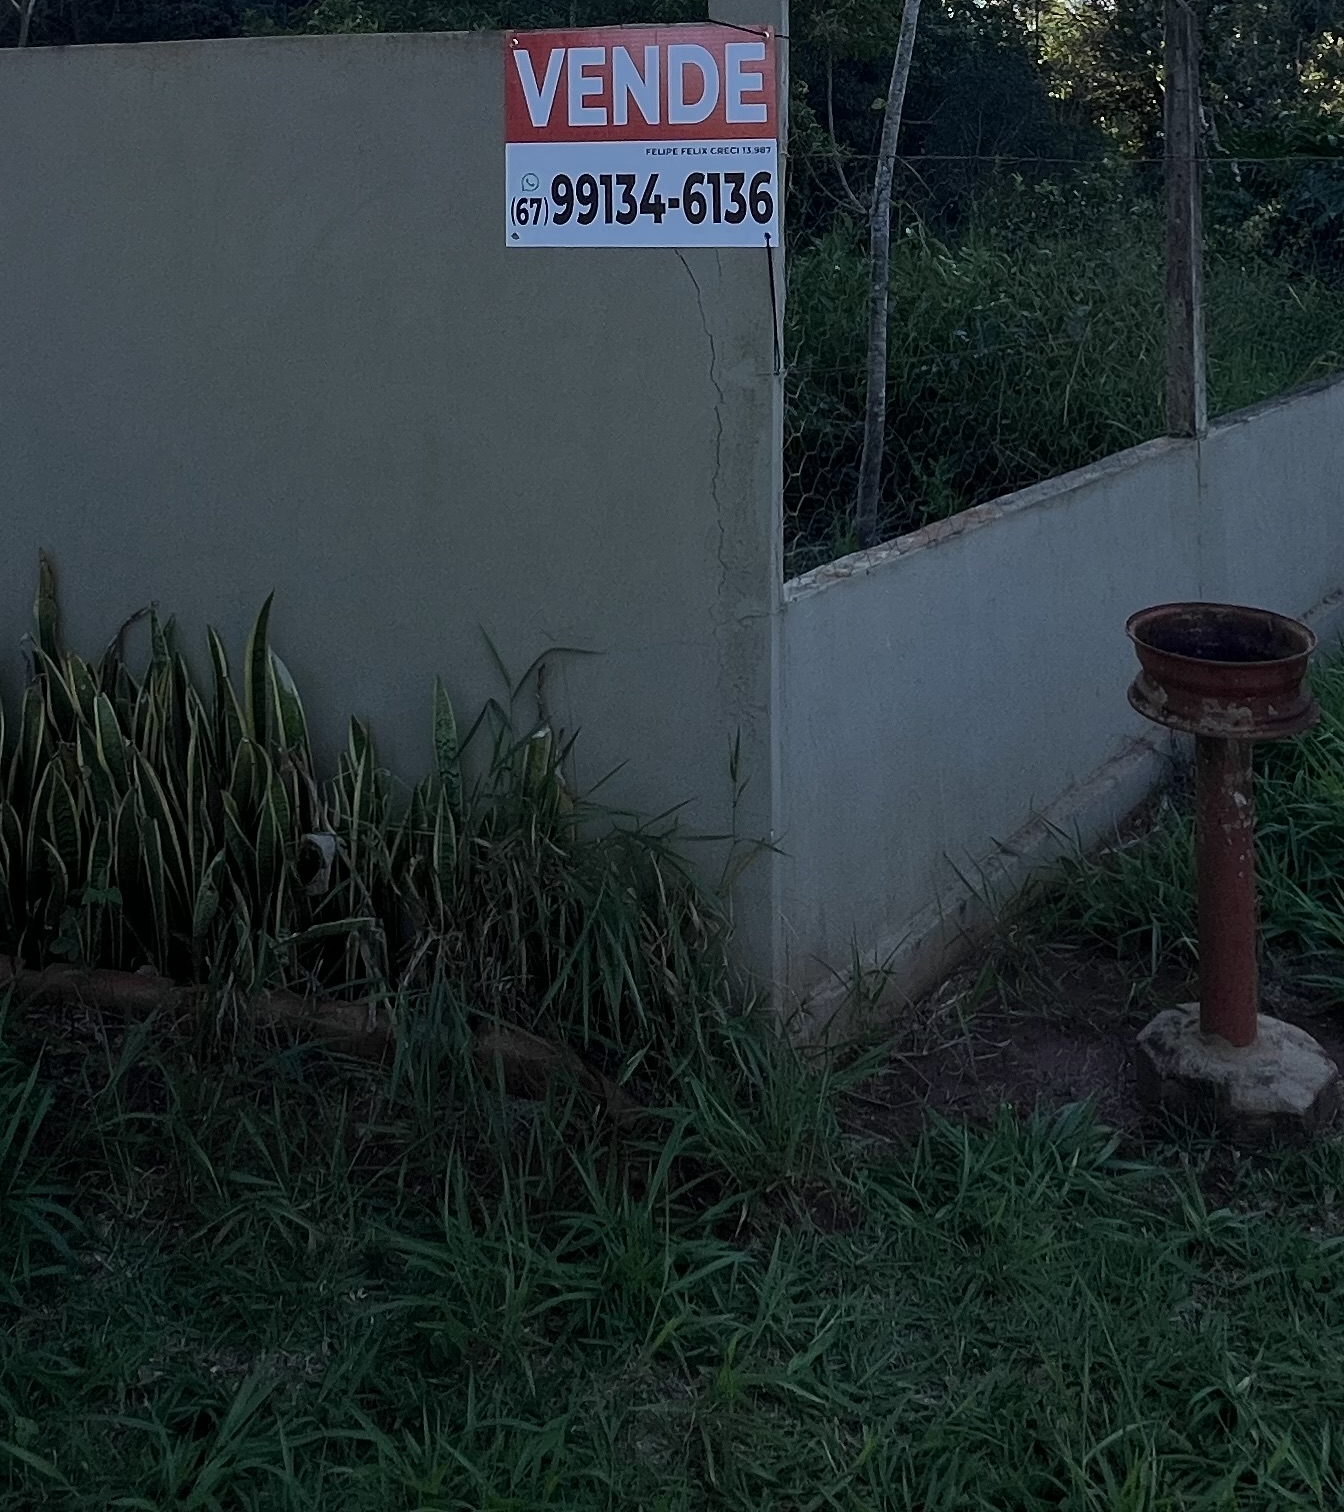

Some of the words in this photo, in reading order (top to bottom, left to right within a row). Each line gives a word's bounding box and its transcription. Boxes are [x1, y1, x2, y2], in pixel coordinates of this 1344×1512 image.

[513, 42, 768, 128] VENDE
[645, 147, 678, 156] FELIPE
[680, 147, 708, 156] FELIX
[709, 146, 740, 155] CRECI
[511, 196, 549, 226] (67)
[551, 171, 774, 225] 99134-6136
